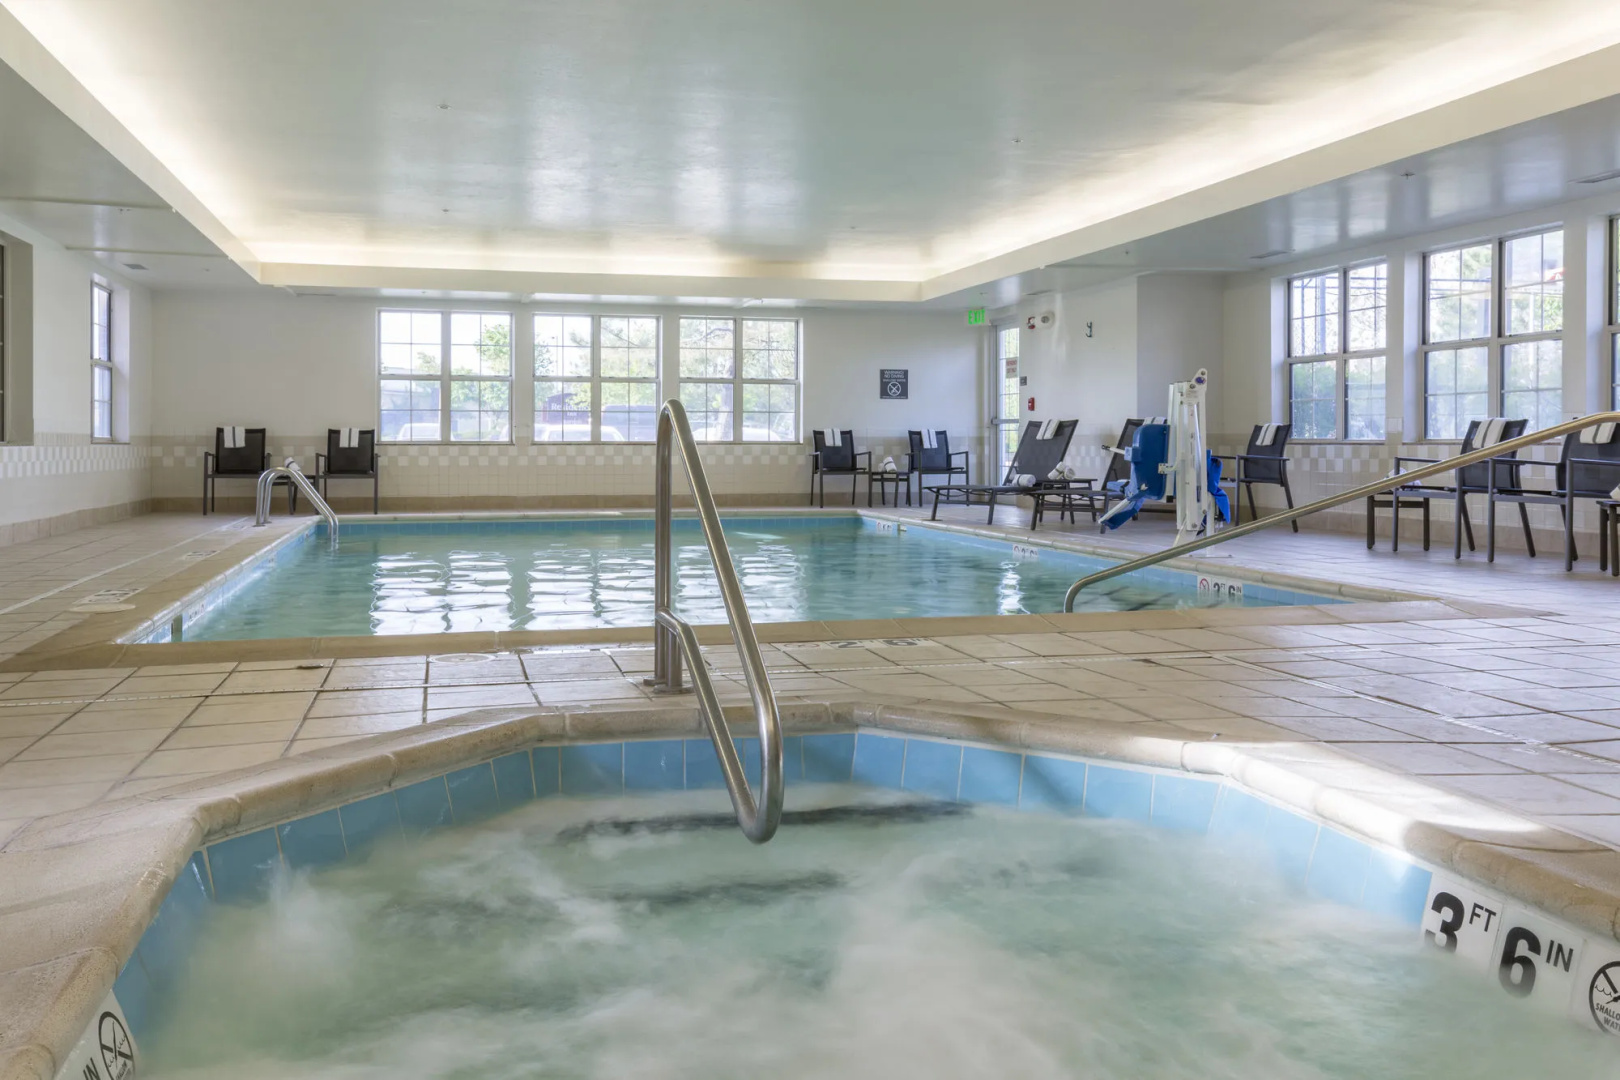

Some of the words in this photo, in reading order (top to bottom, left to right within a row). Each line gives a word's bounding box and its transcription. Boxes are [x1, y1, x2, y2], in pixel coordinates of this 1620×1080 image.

[968, 309, 985, 324] EXIT
[1425, 891, 1464, 953] 3
[1469, 902, 1496, 932] FT
[1499, 926, 1541, 998] 6
[1546, 939, 1574, 972] IN
[1604, 1016, 1620, 1032] WAT
